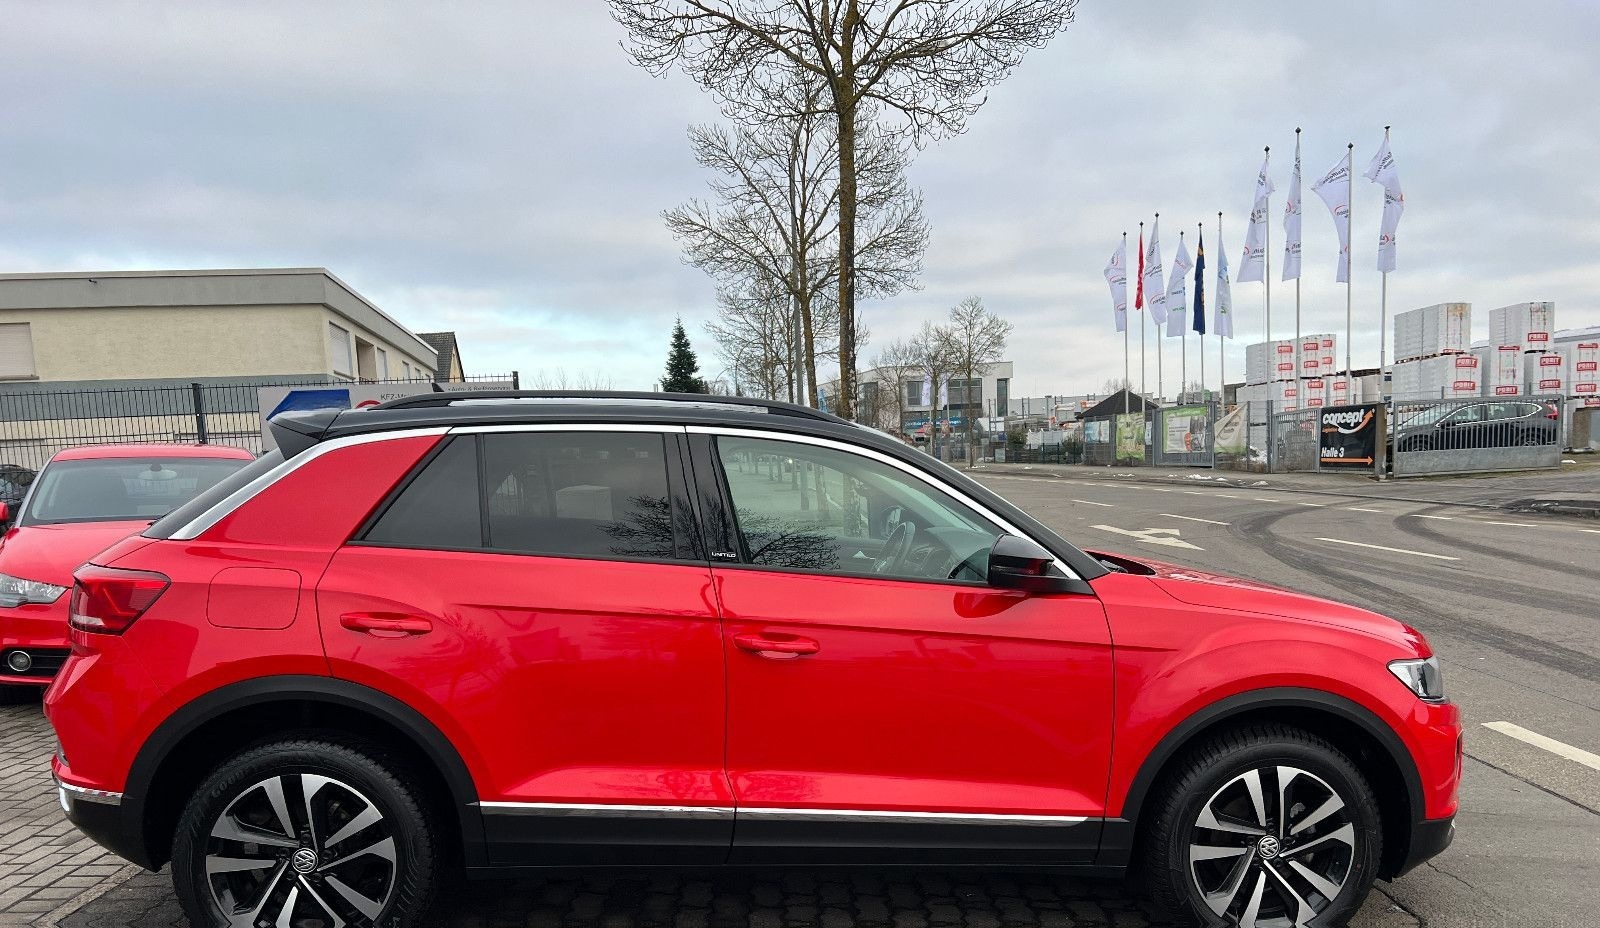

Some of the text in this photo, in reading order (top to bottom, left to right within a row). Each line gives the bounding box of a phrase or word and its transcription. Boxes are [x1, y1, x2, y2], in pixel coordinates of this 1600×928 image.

[1322, 408, 1365, 427] concept
[1321, 447, 1345, 458] Halle 3
